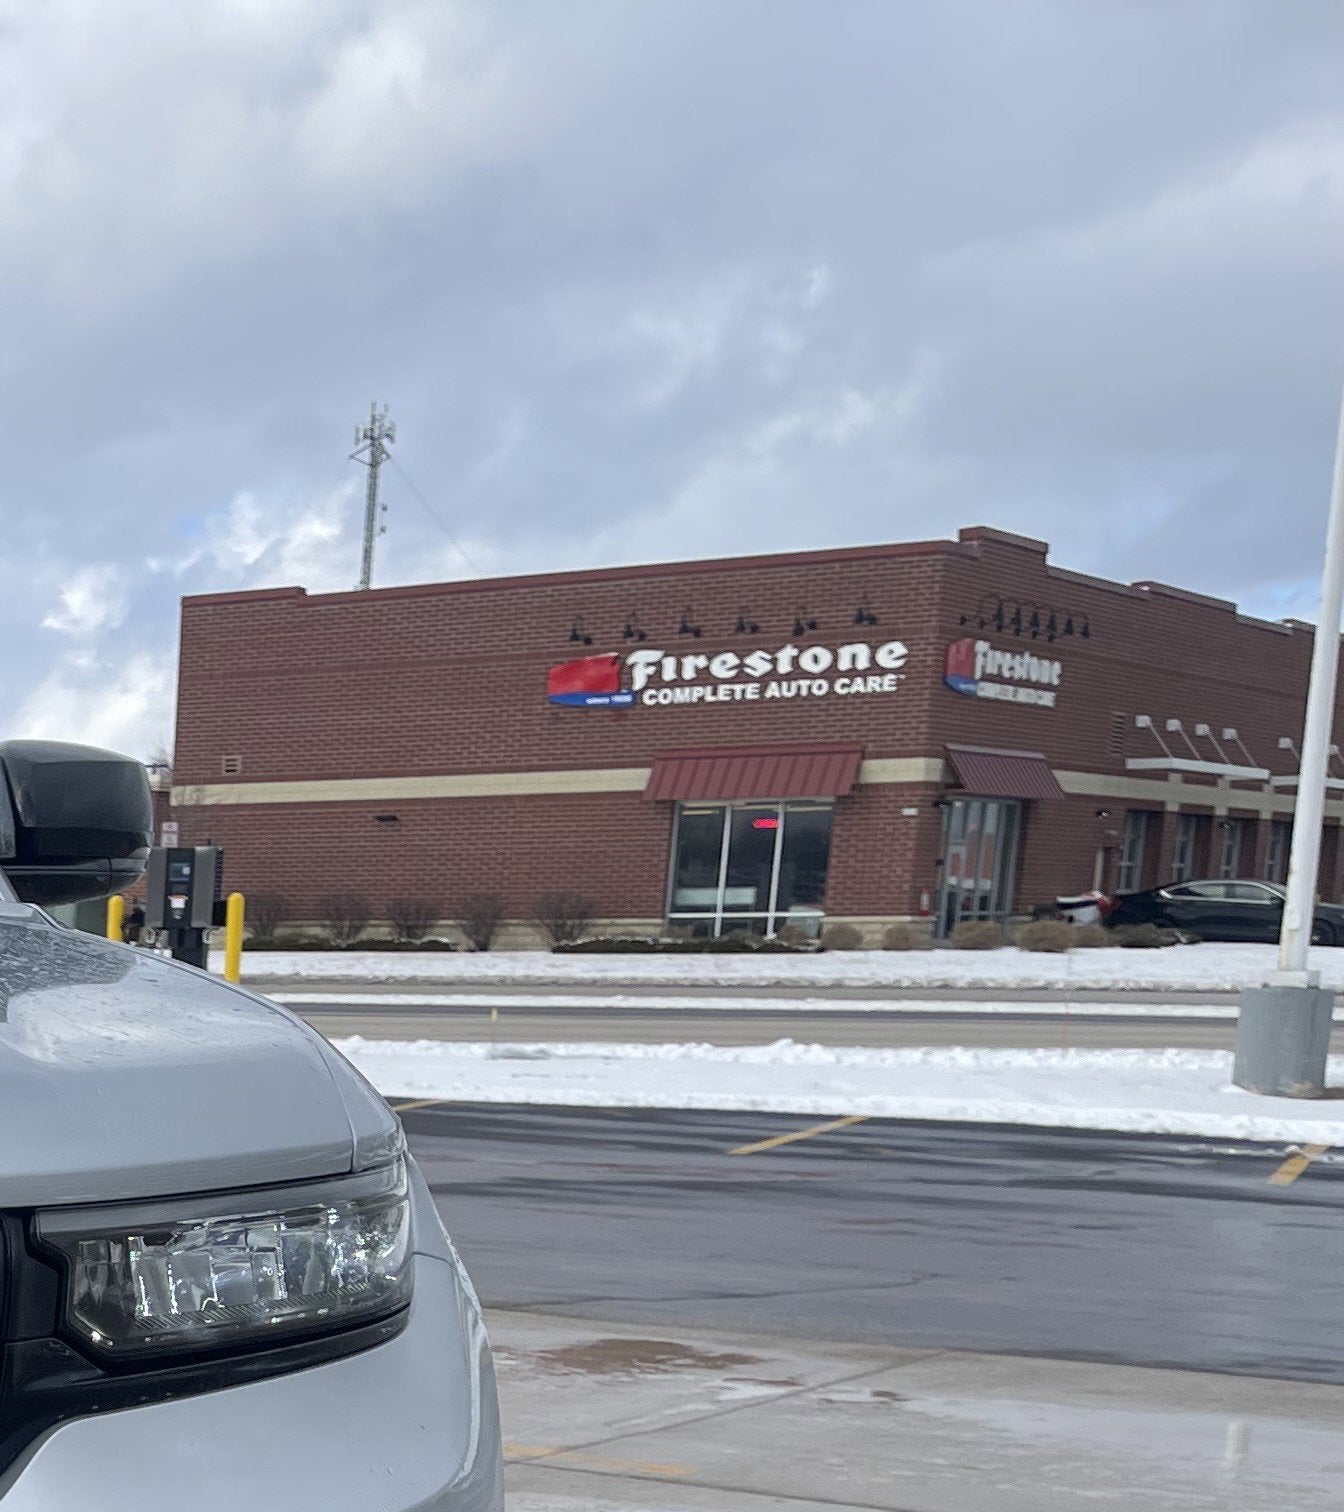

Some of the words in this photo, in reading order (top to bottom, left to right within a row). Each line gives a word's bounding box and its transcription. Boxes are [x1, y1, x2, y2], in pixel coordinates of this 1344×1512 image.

[625, 641, 909, 691] Firestone
[974, 640, 1062, 686] Firestone
[642, 683, 760, 705] COMPLETE
[764, 679, 829, 699] AUTO
[834, 673, 899, 695] CARE
